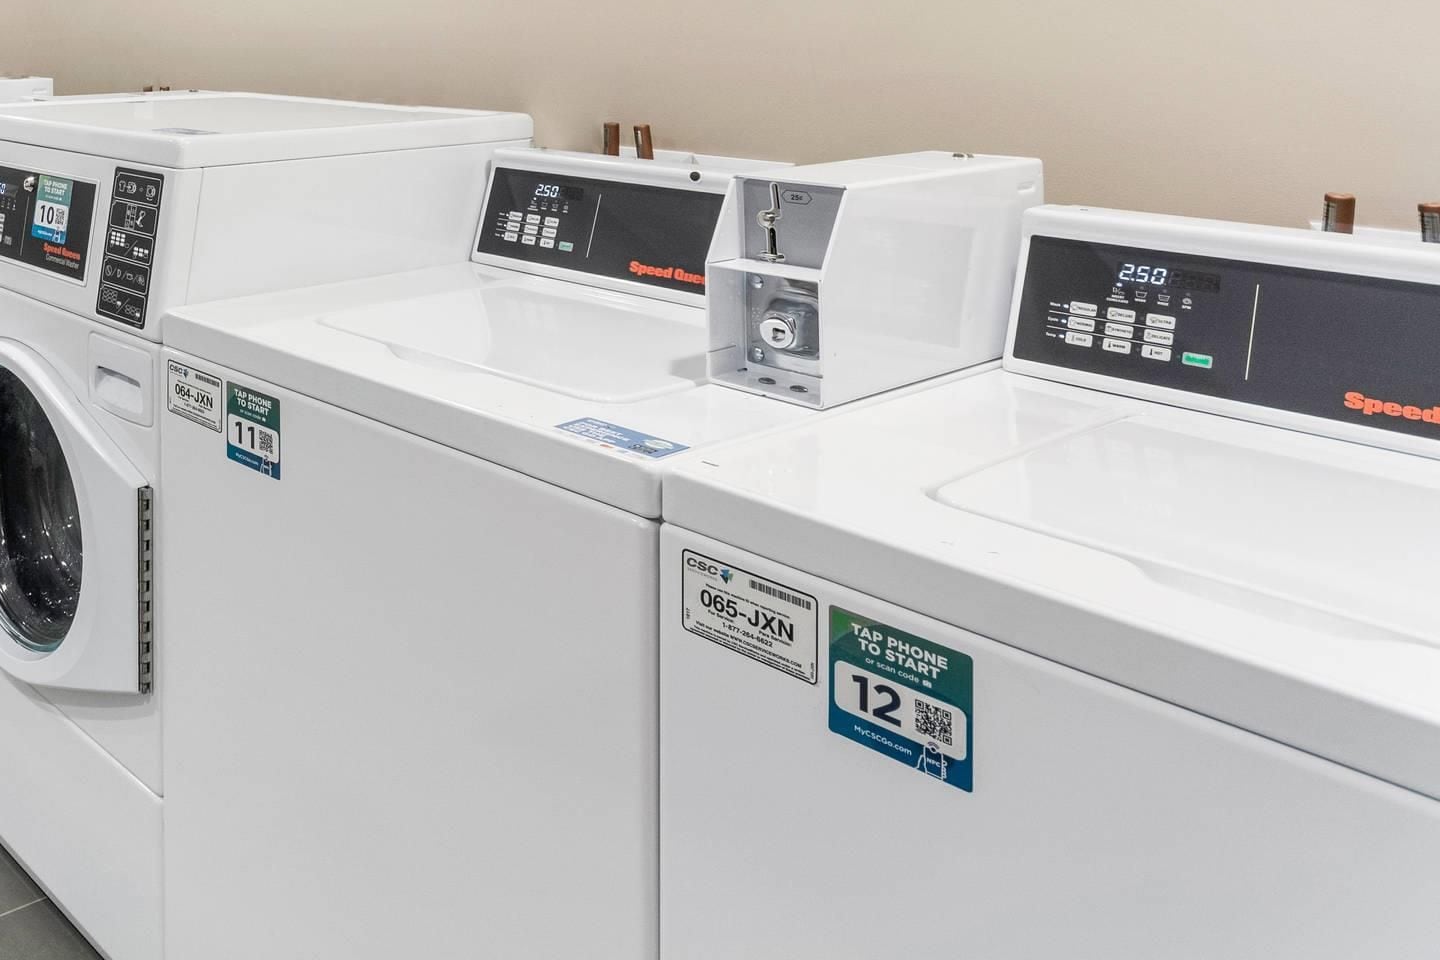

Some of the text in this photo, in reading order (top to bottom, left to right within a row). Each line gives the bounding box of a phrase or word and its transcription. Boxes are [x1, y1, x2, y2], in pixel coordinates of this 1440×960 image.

[40, 205, 55, 224] 10
[629, 260, 674, 278] Speed
[1119, 263, 1167, 285] 2.50
[175, 383, 213, 408] 064-JXN
[234, 388, 272, 409] TAP PHONE
[237, 398, 247, 407] TO
[248, 402, 269, 416] START
[1344, 391, 1440, 423] Speed
[235, 421, 255, 449] 11
[687, 557, 718, 575] CSC
[700, 589, 794, 643] 065-JXN
[851, 623, 948, 670] TAP PHONE
[858, 638, 940, 679] TO START
[865, 657, 919, 683] or scan code
[852, 674, 902, 728] 12
[854, 725, 912, 756] MyCSCGo.com
